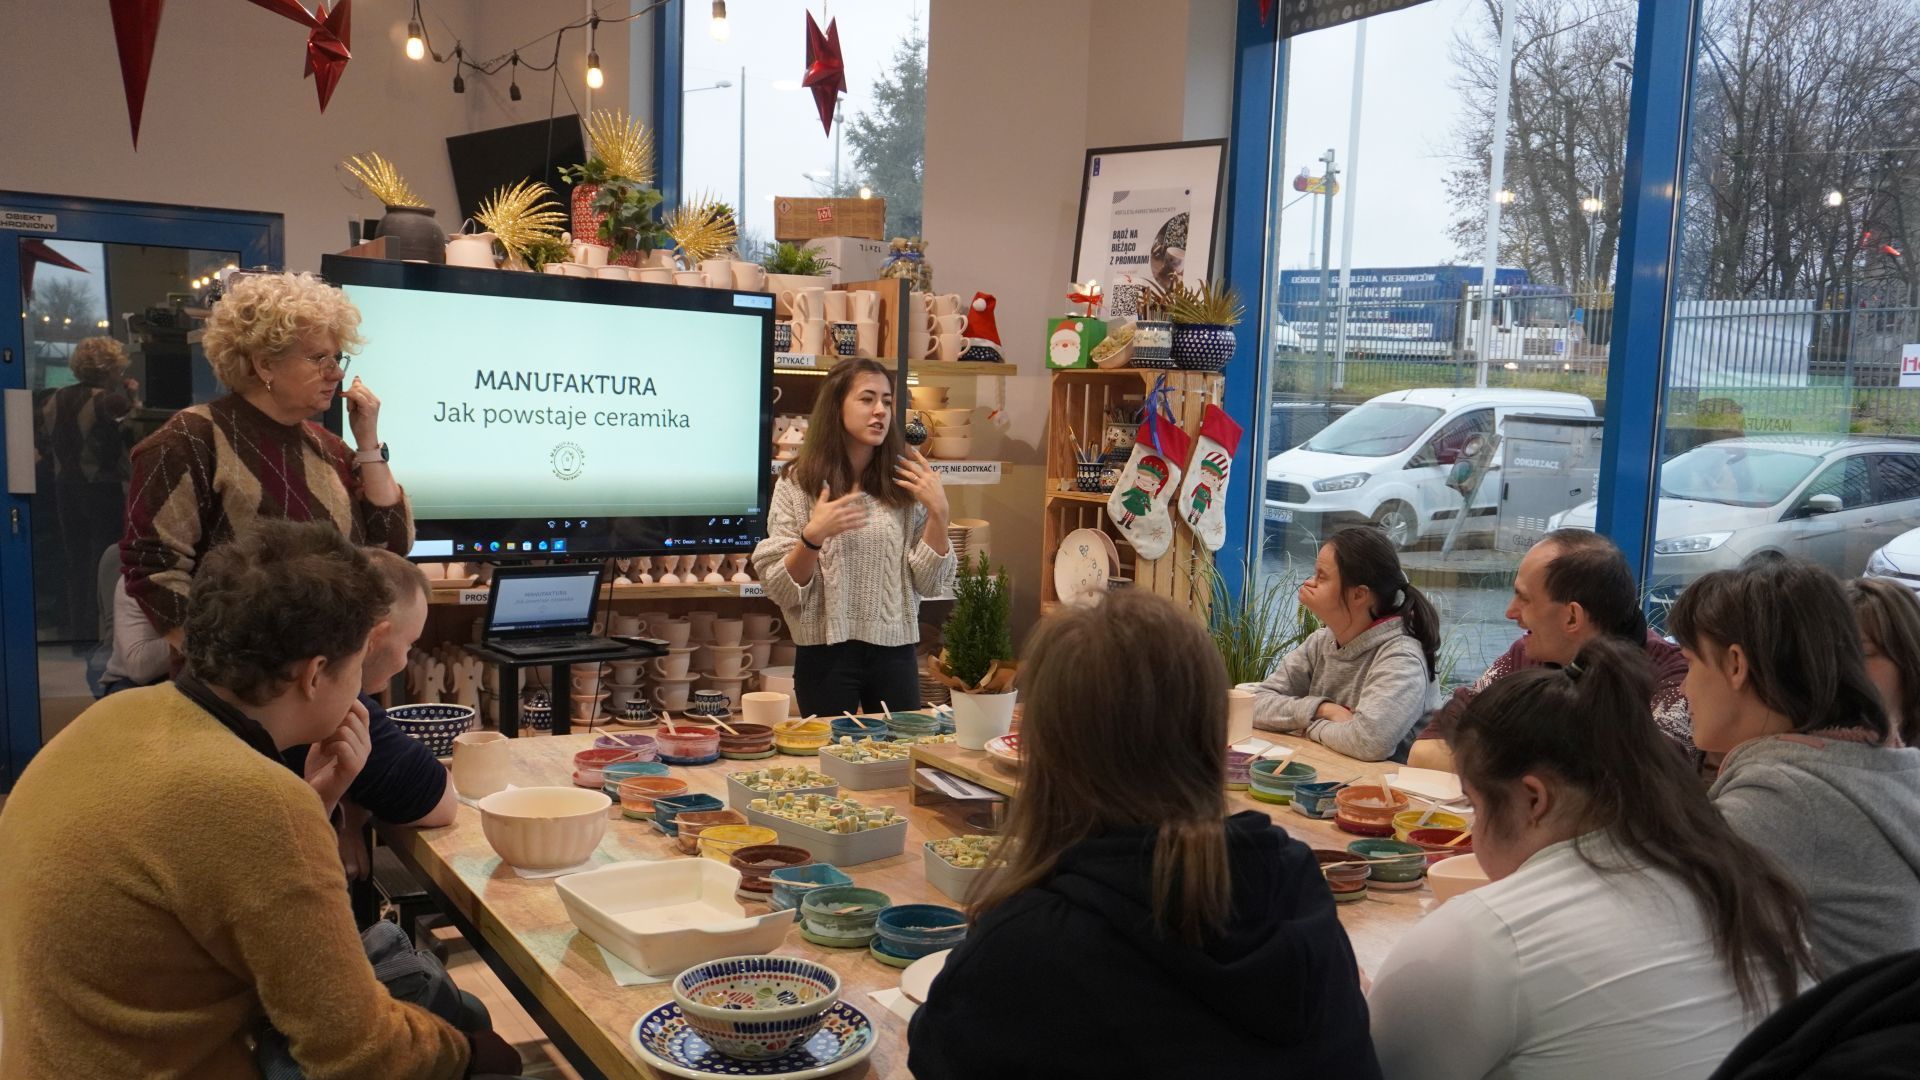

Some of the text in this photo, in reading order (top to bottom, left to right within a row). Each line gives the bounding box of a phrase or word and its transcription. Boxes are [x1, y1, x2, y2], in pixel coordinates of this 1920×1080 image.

[5, 212, 43, 221] OBIEKT
[0, 220, 54, 229] HRONIONY
[1112, 228, 1138, 241] BĄDŹ NA
[1111, 241, 1136, 254] BIEŻĄCO
[1109, 255, 1149, 265] Z PROMKAMI
[1381, 273, 1436, 282] KIEROWCÓW
[474, 369, 657, 396] MANUFAKTURA
[433, 401, 691, 431] Jak powstaje ceramika
[950, 465, 961, 473] NIE
[962, 464, 992, 473] DOTYKAĆ
[744, 587, 764, 595] PROS
[465, 594, 488, 602] PROS
